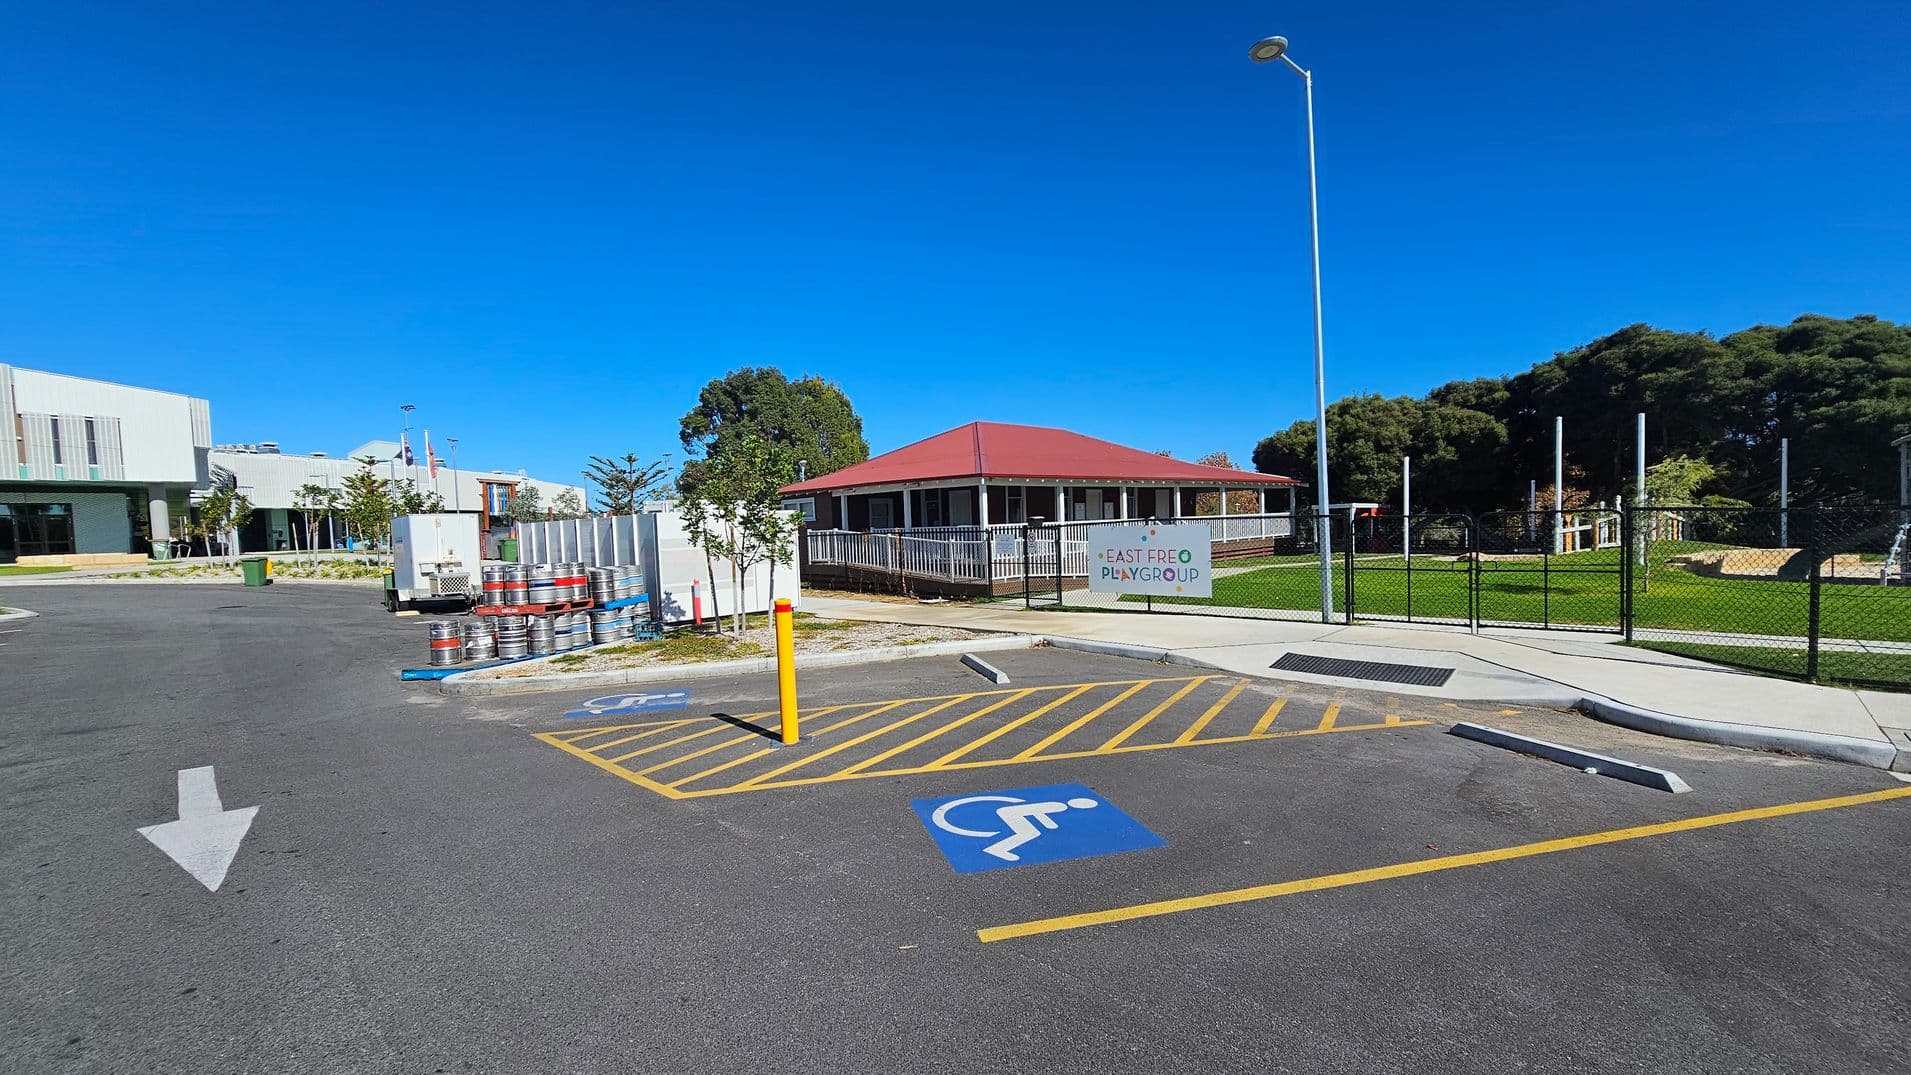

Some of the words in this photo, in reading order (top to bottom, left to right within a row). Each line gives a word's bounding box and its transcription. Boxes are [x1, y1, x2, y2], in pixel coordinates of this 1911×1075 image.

[1107, 549, 1142, 563] EAST
[1148, 548, 1192, 564] FREO
[1102, 567, 1199, 582] PLAYGROUP
